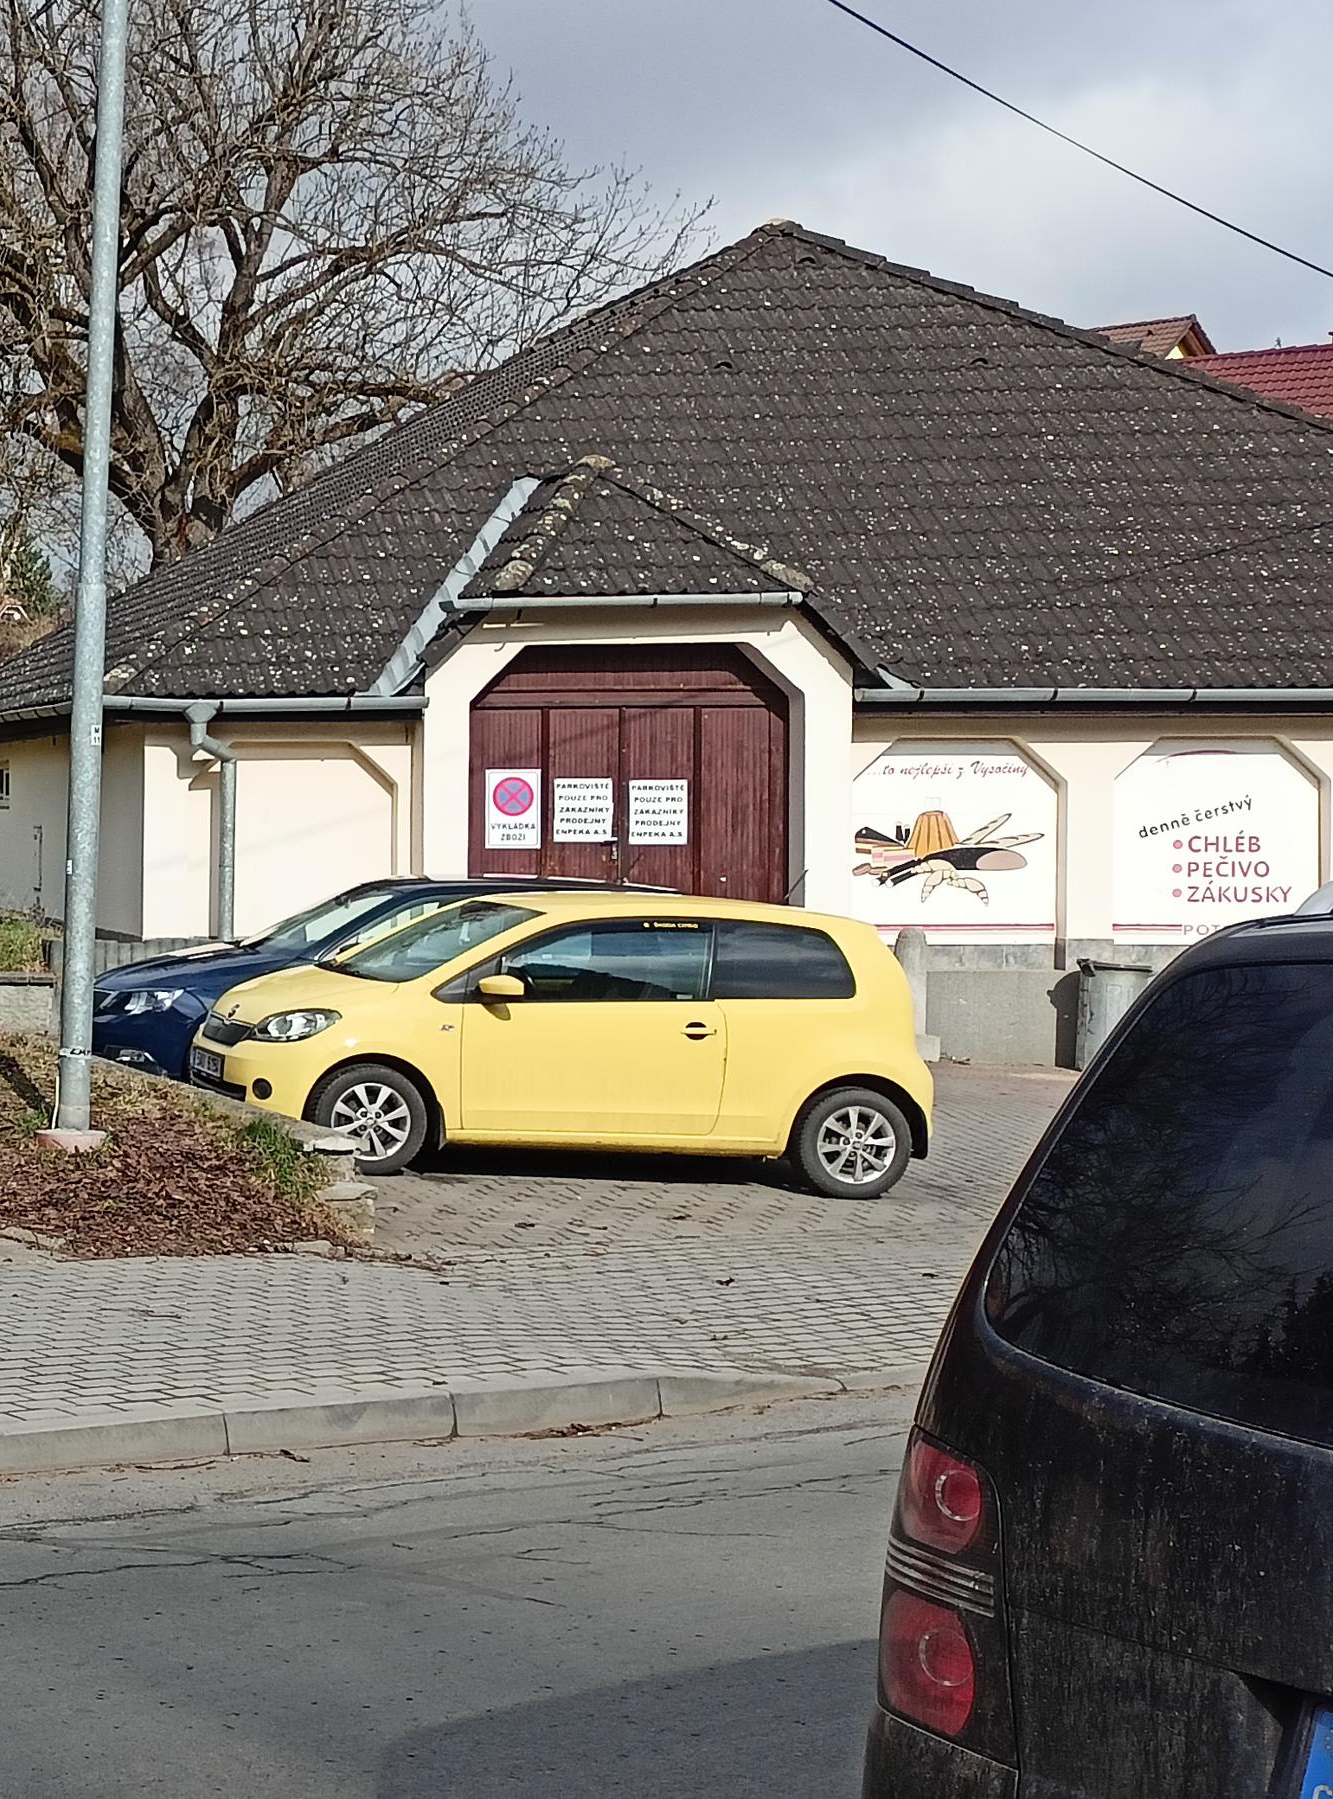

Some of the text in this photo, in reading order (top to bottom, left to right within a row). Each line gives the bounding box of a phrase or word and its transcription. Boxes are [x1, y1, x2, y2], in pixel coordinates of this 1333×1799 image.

[899, 761, 954, 780] nejlepší
[956, 766, 964, 780] z
[969, 760, 1030, 778] Vysočiny
[490, 821, 537, 830] VYKLÁDKA
[1138, 794, 1253, 839] denně čerstvý
[1187, 830, 1261, 853] CHLÉB
[1186, 855, 1271, 878] PEČIVO
[1186, 880, 1292, 903] ZÁKUSKY
